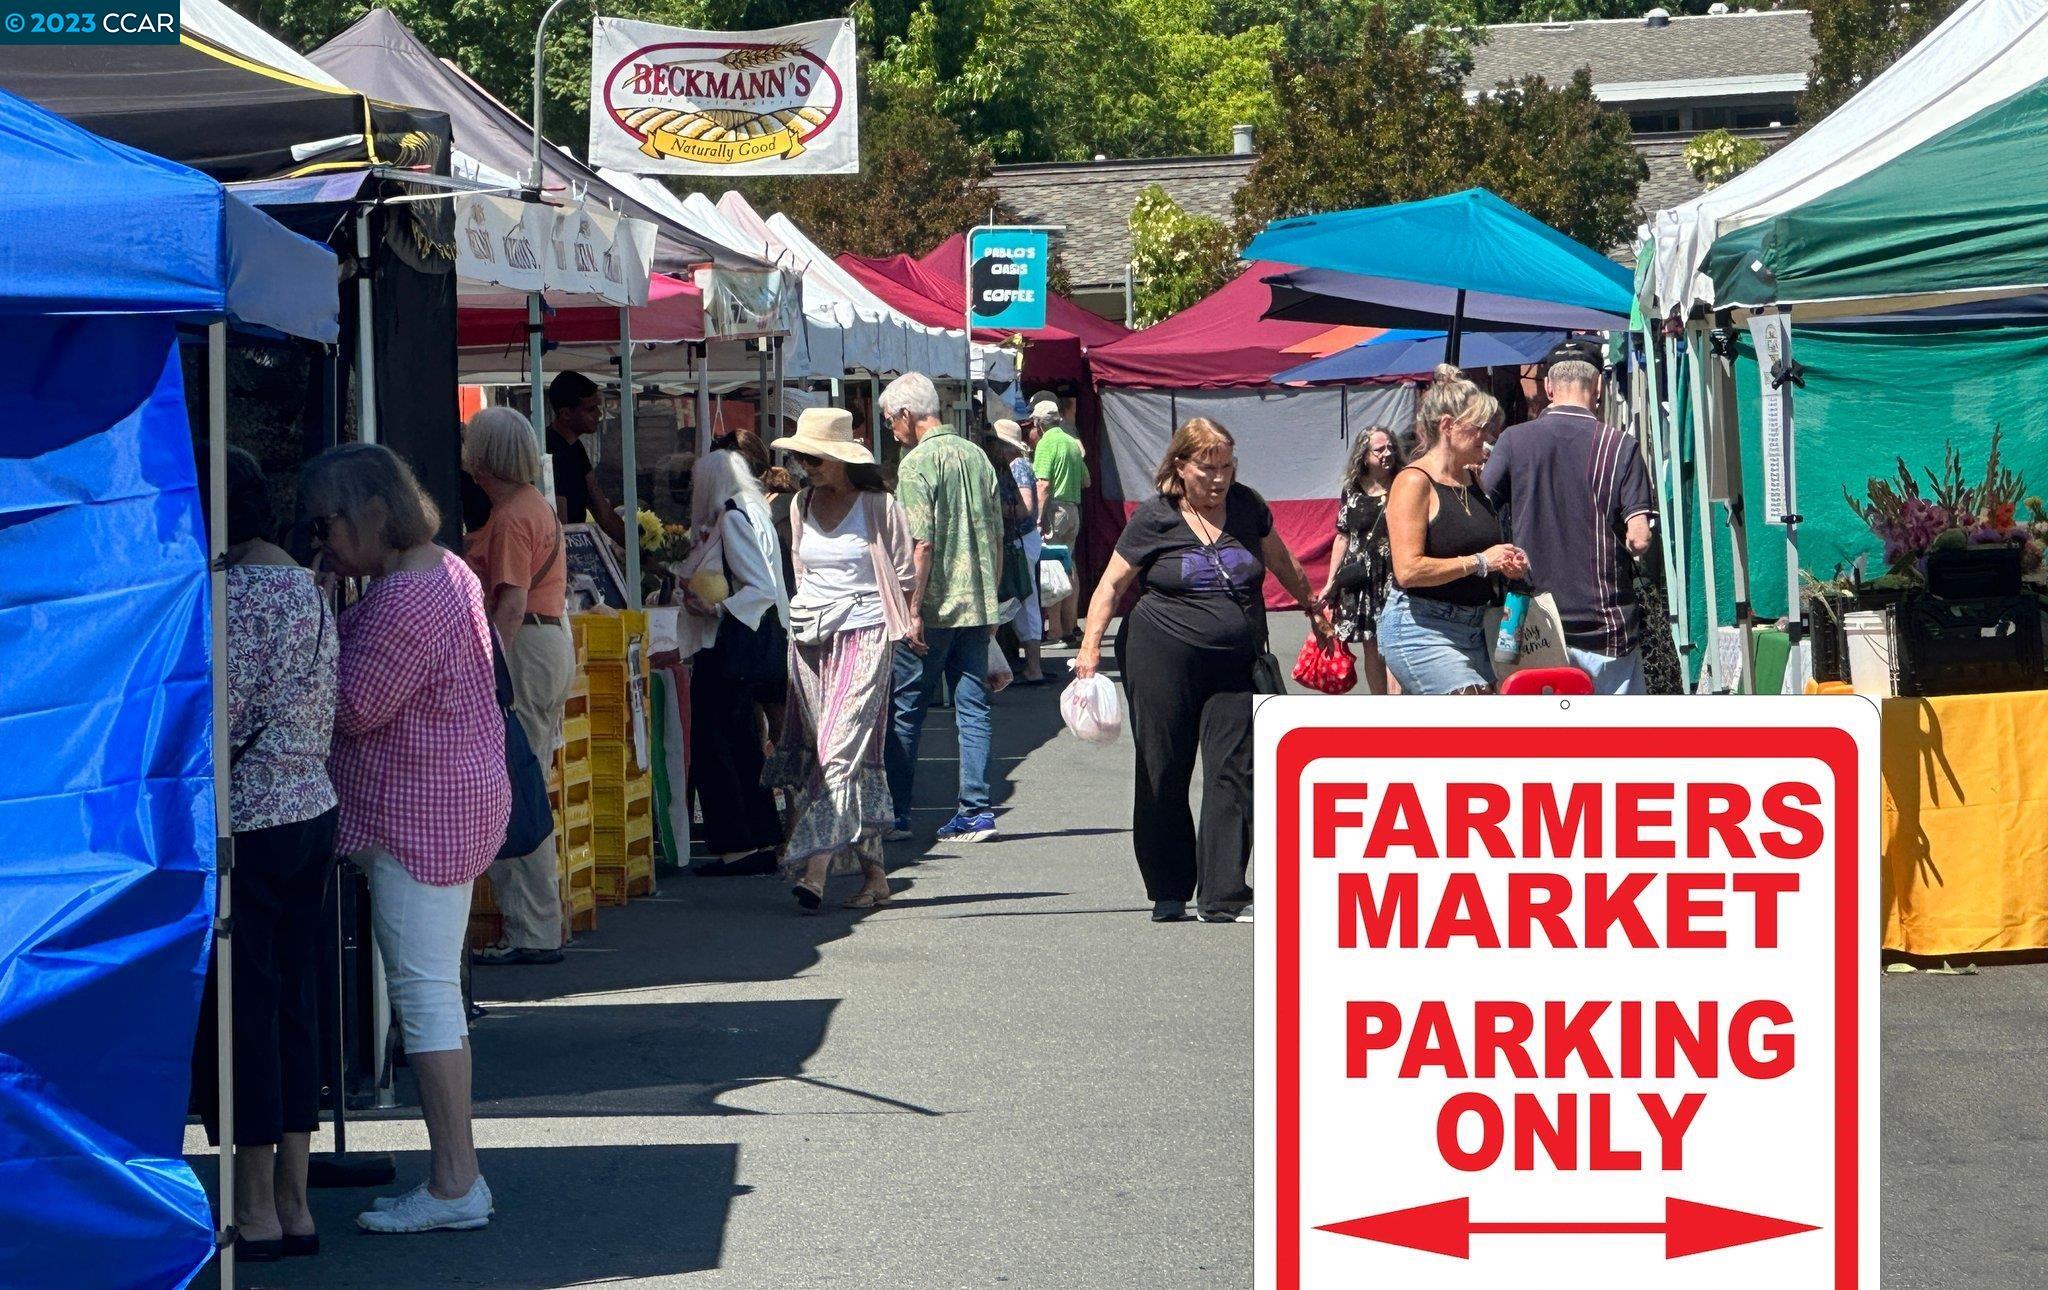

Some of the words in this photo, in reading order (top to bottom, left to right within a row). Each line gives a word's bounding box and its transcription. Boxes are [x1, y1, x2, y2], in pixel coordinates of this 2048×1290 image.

[632, 62, 811, 99] BECKMANN'S
[670, 137, 735, 162] Naturally
[738, 137, 777, 157] Good
[984, 247, 1035, 258] PABLO'S
[991, 264, 1028, 275] OASIS
[982, 289, 1036, 302] COFFEE
